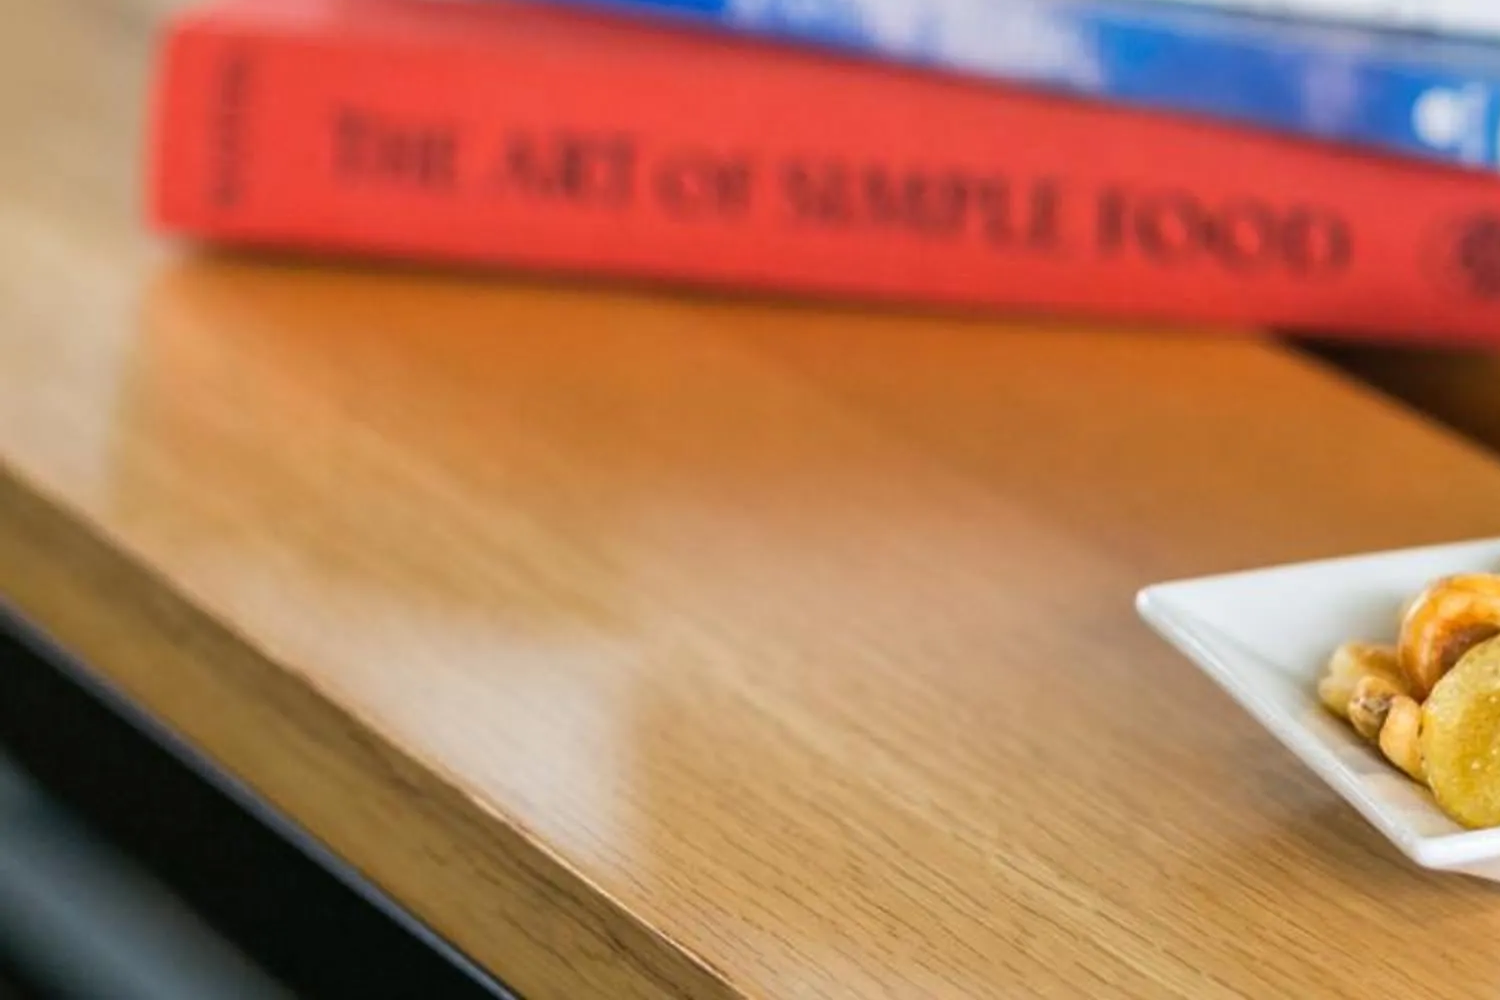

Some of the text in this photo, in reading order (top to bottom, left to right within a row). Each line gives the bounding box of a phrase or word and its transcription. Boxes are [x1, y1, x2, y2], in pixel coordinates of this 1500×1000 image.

[331, 103, 459, 192] THE
[502, 130, 636, 207] ART
[784, 160, 1063, 262] SIMPLE
[1096, 186, 1356, 284] FOOD
